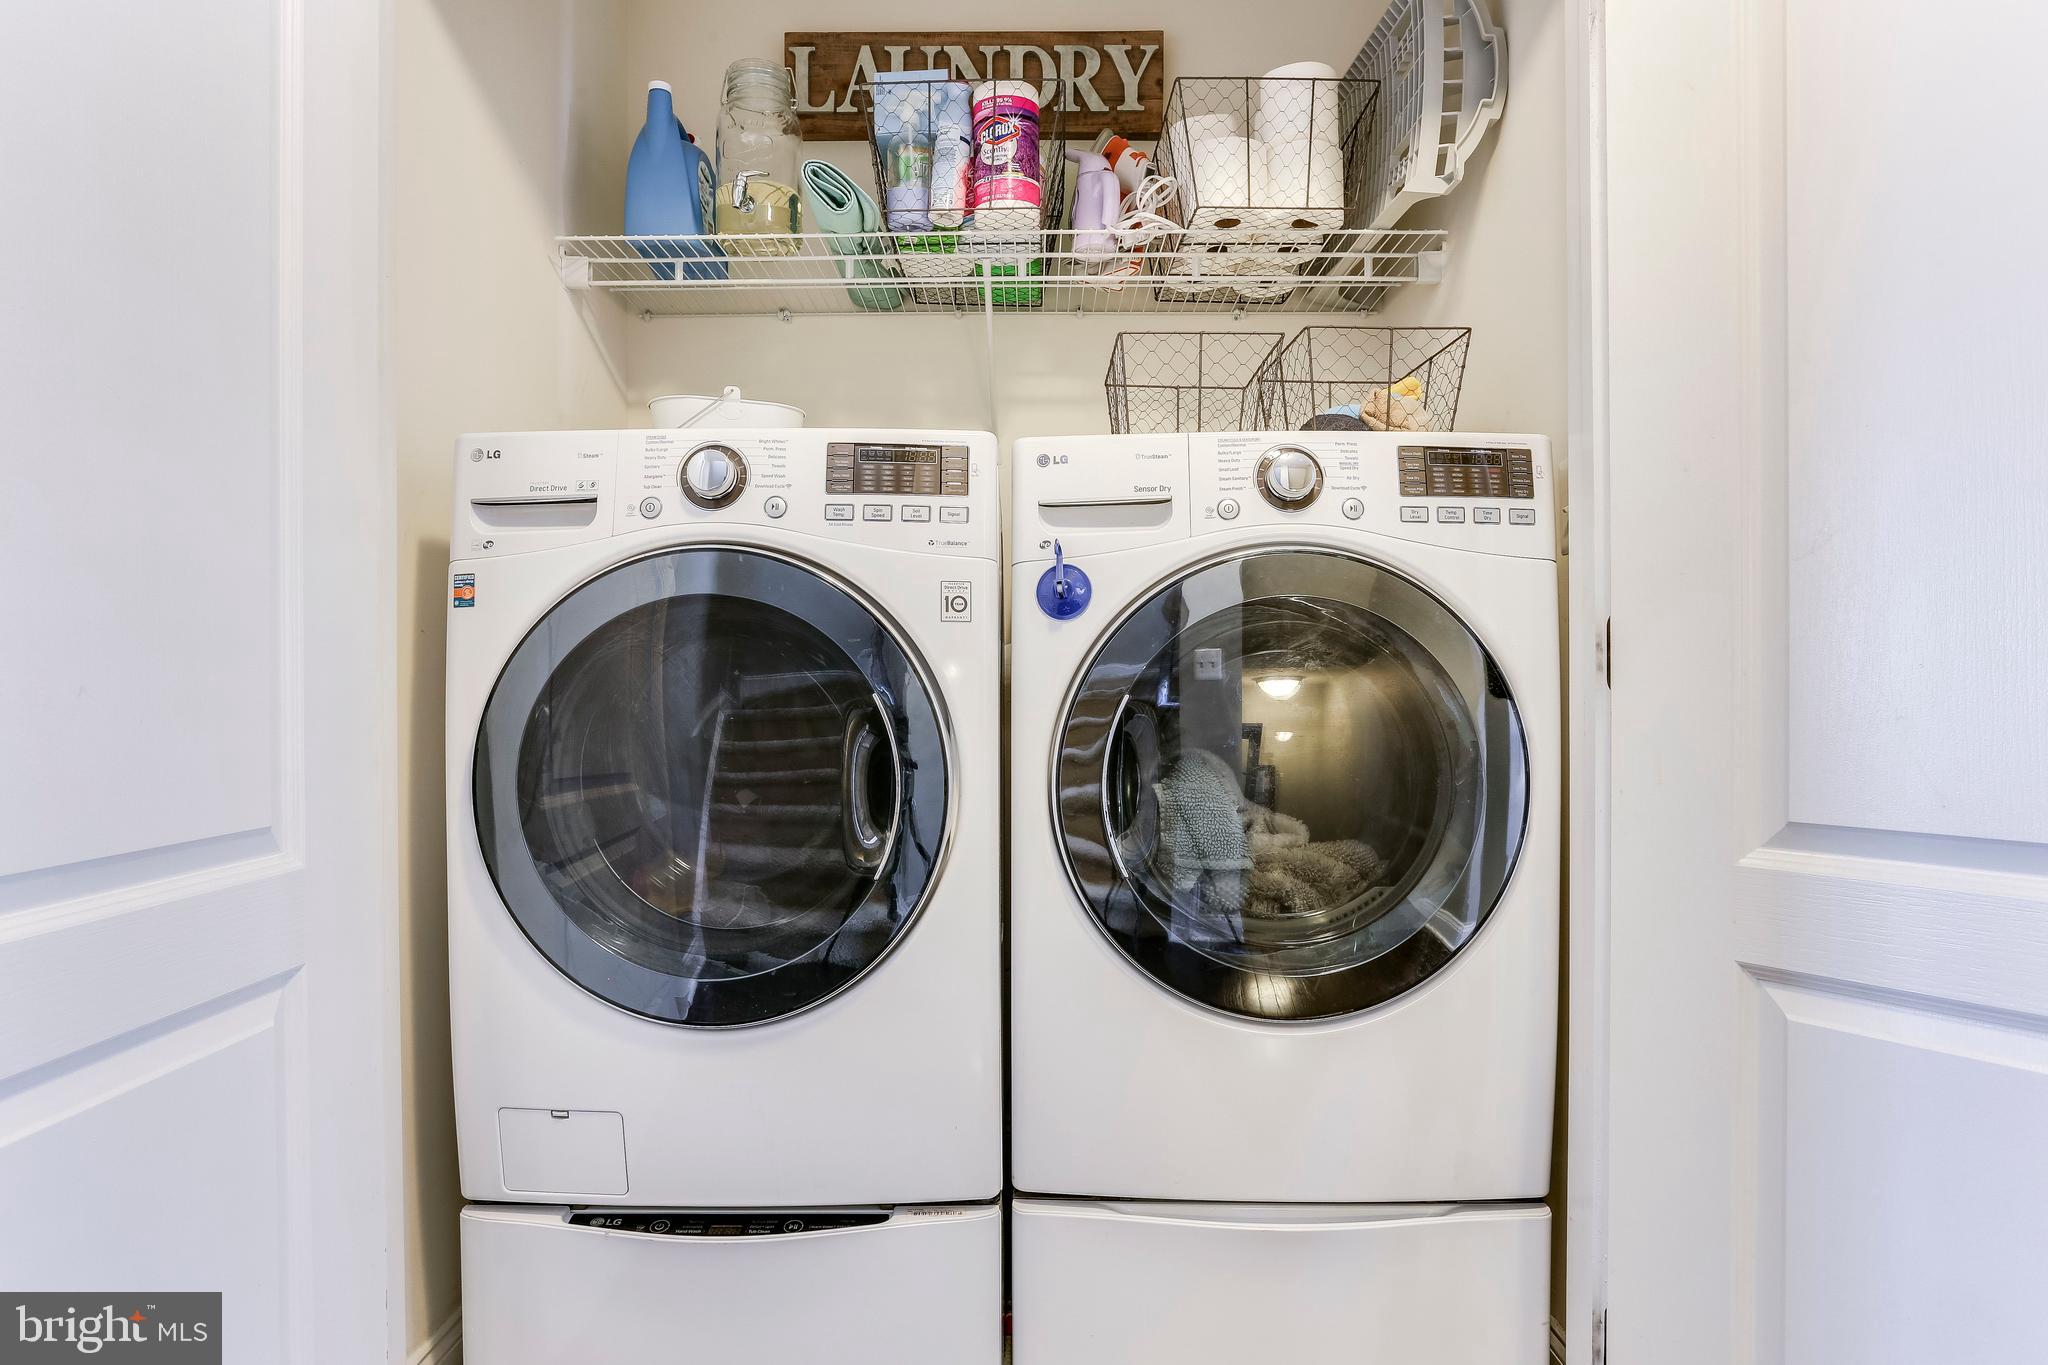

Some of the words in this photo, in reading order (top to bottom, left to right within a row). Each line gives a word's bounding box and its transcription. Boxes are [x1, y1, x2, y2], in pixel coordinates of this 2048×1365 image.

[486, 450, 502, 460] LG
[1053, 454, 1069, 465] LG
[529, 484, 549, 492] Direct
[550, 484, 568, 492] Drive
[1133, 485, 1157, 493] Sensor
[1159, 485, 1172, 493] Dry
[944, 595, 968, 613] 10
[605, 1218, 622, 1226] LG
